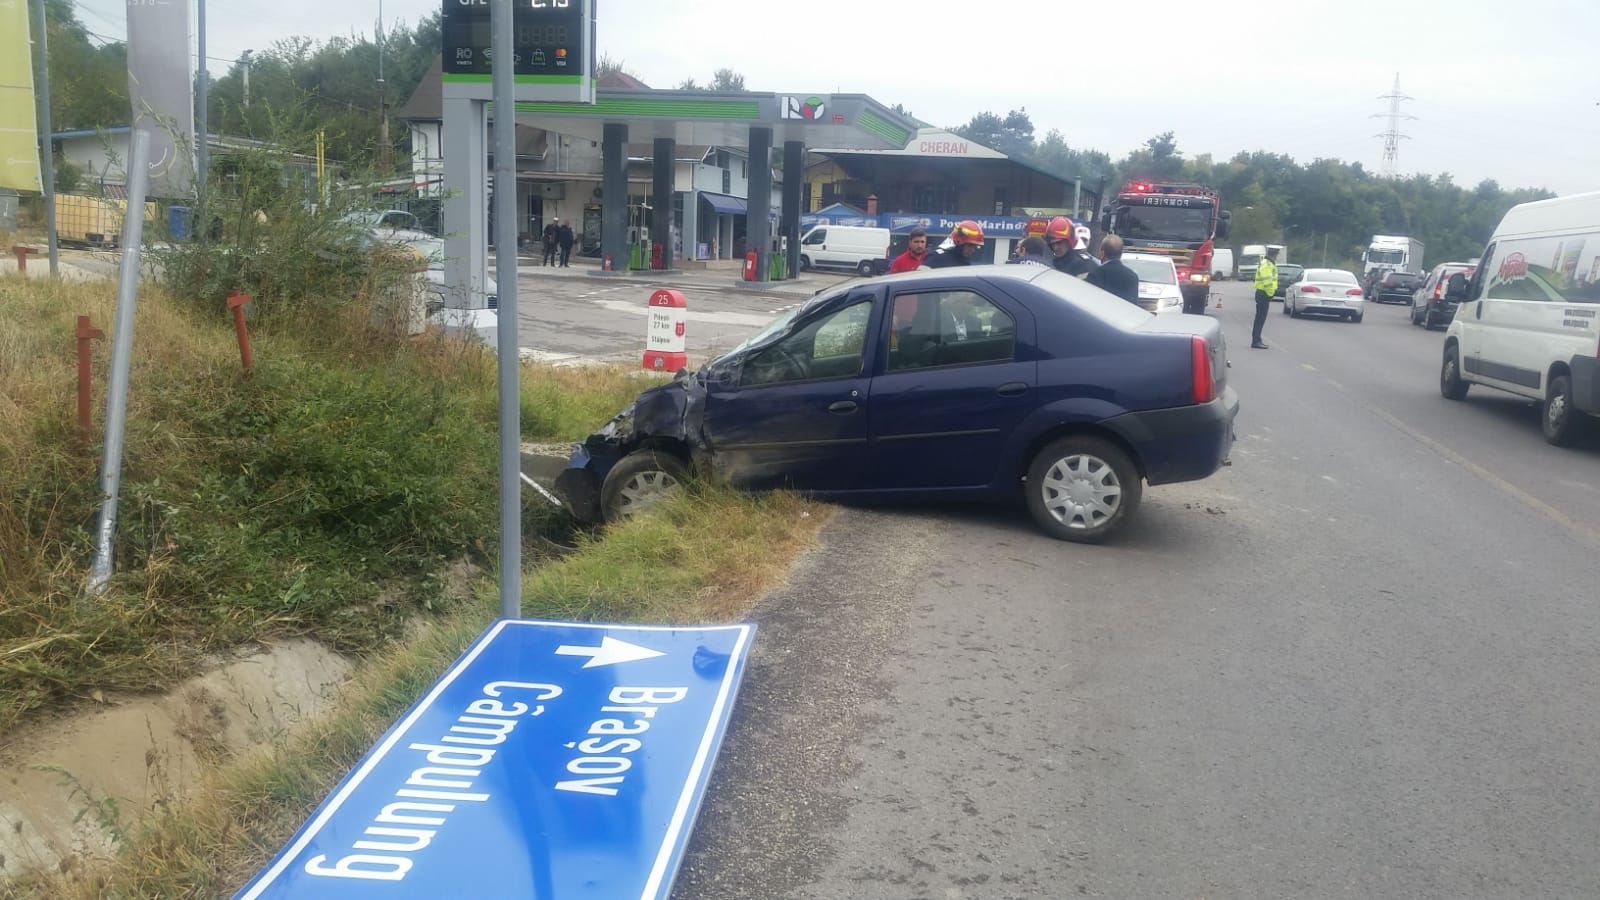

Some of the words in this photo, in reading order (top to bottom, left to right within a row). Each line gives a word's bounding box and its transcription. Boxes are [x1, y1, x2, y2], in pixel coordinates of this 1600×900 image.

[919, 141, 968, 154] CHERAN
[658, 294, 669, 305] 25
[554, 686, 689, 797] Brașov
[305, 681, 563, 881] Câmpulung
